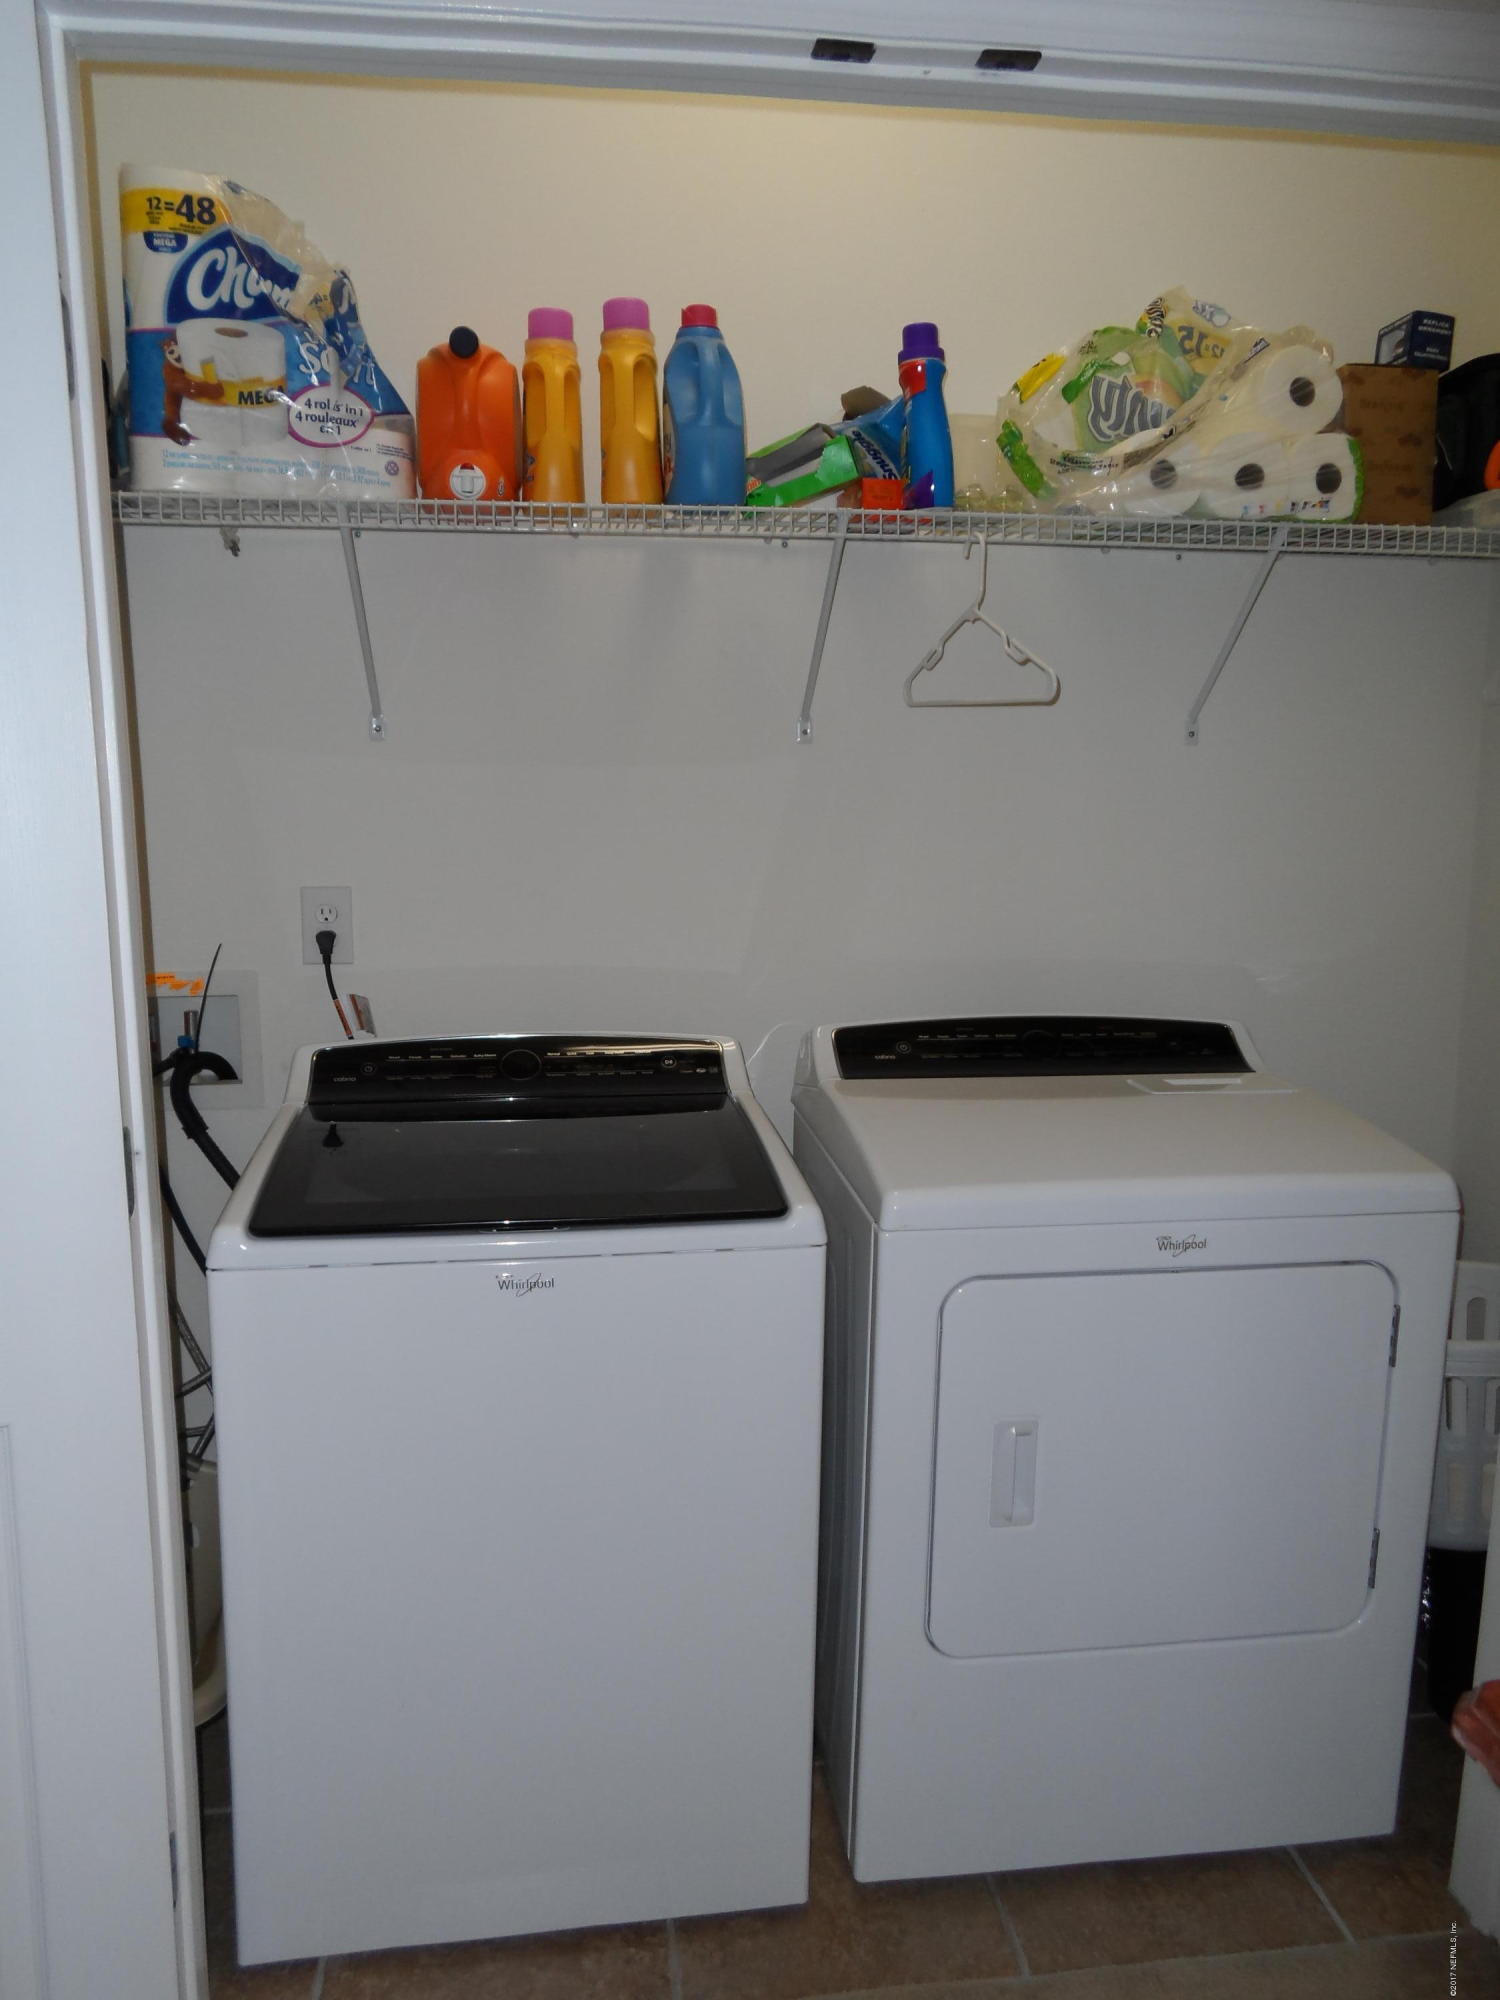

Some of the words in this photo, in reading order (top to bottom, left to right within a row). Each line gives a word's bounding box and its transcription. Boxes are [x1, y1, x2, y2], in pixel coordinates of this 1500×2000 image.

[304, 398, 312, 409] 4
[346, 404, 357, 416] in
[295, 410, 302, 422] 4
[305, 412, 357, 428] rouleaux
[1156, 1236, 1207, 1254] Whirlpool
[497, 1275, 555, 1294] Whirlpool
